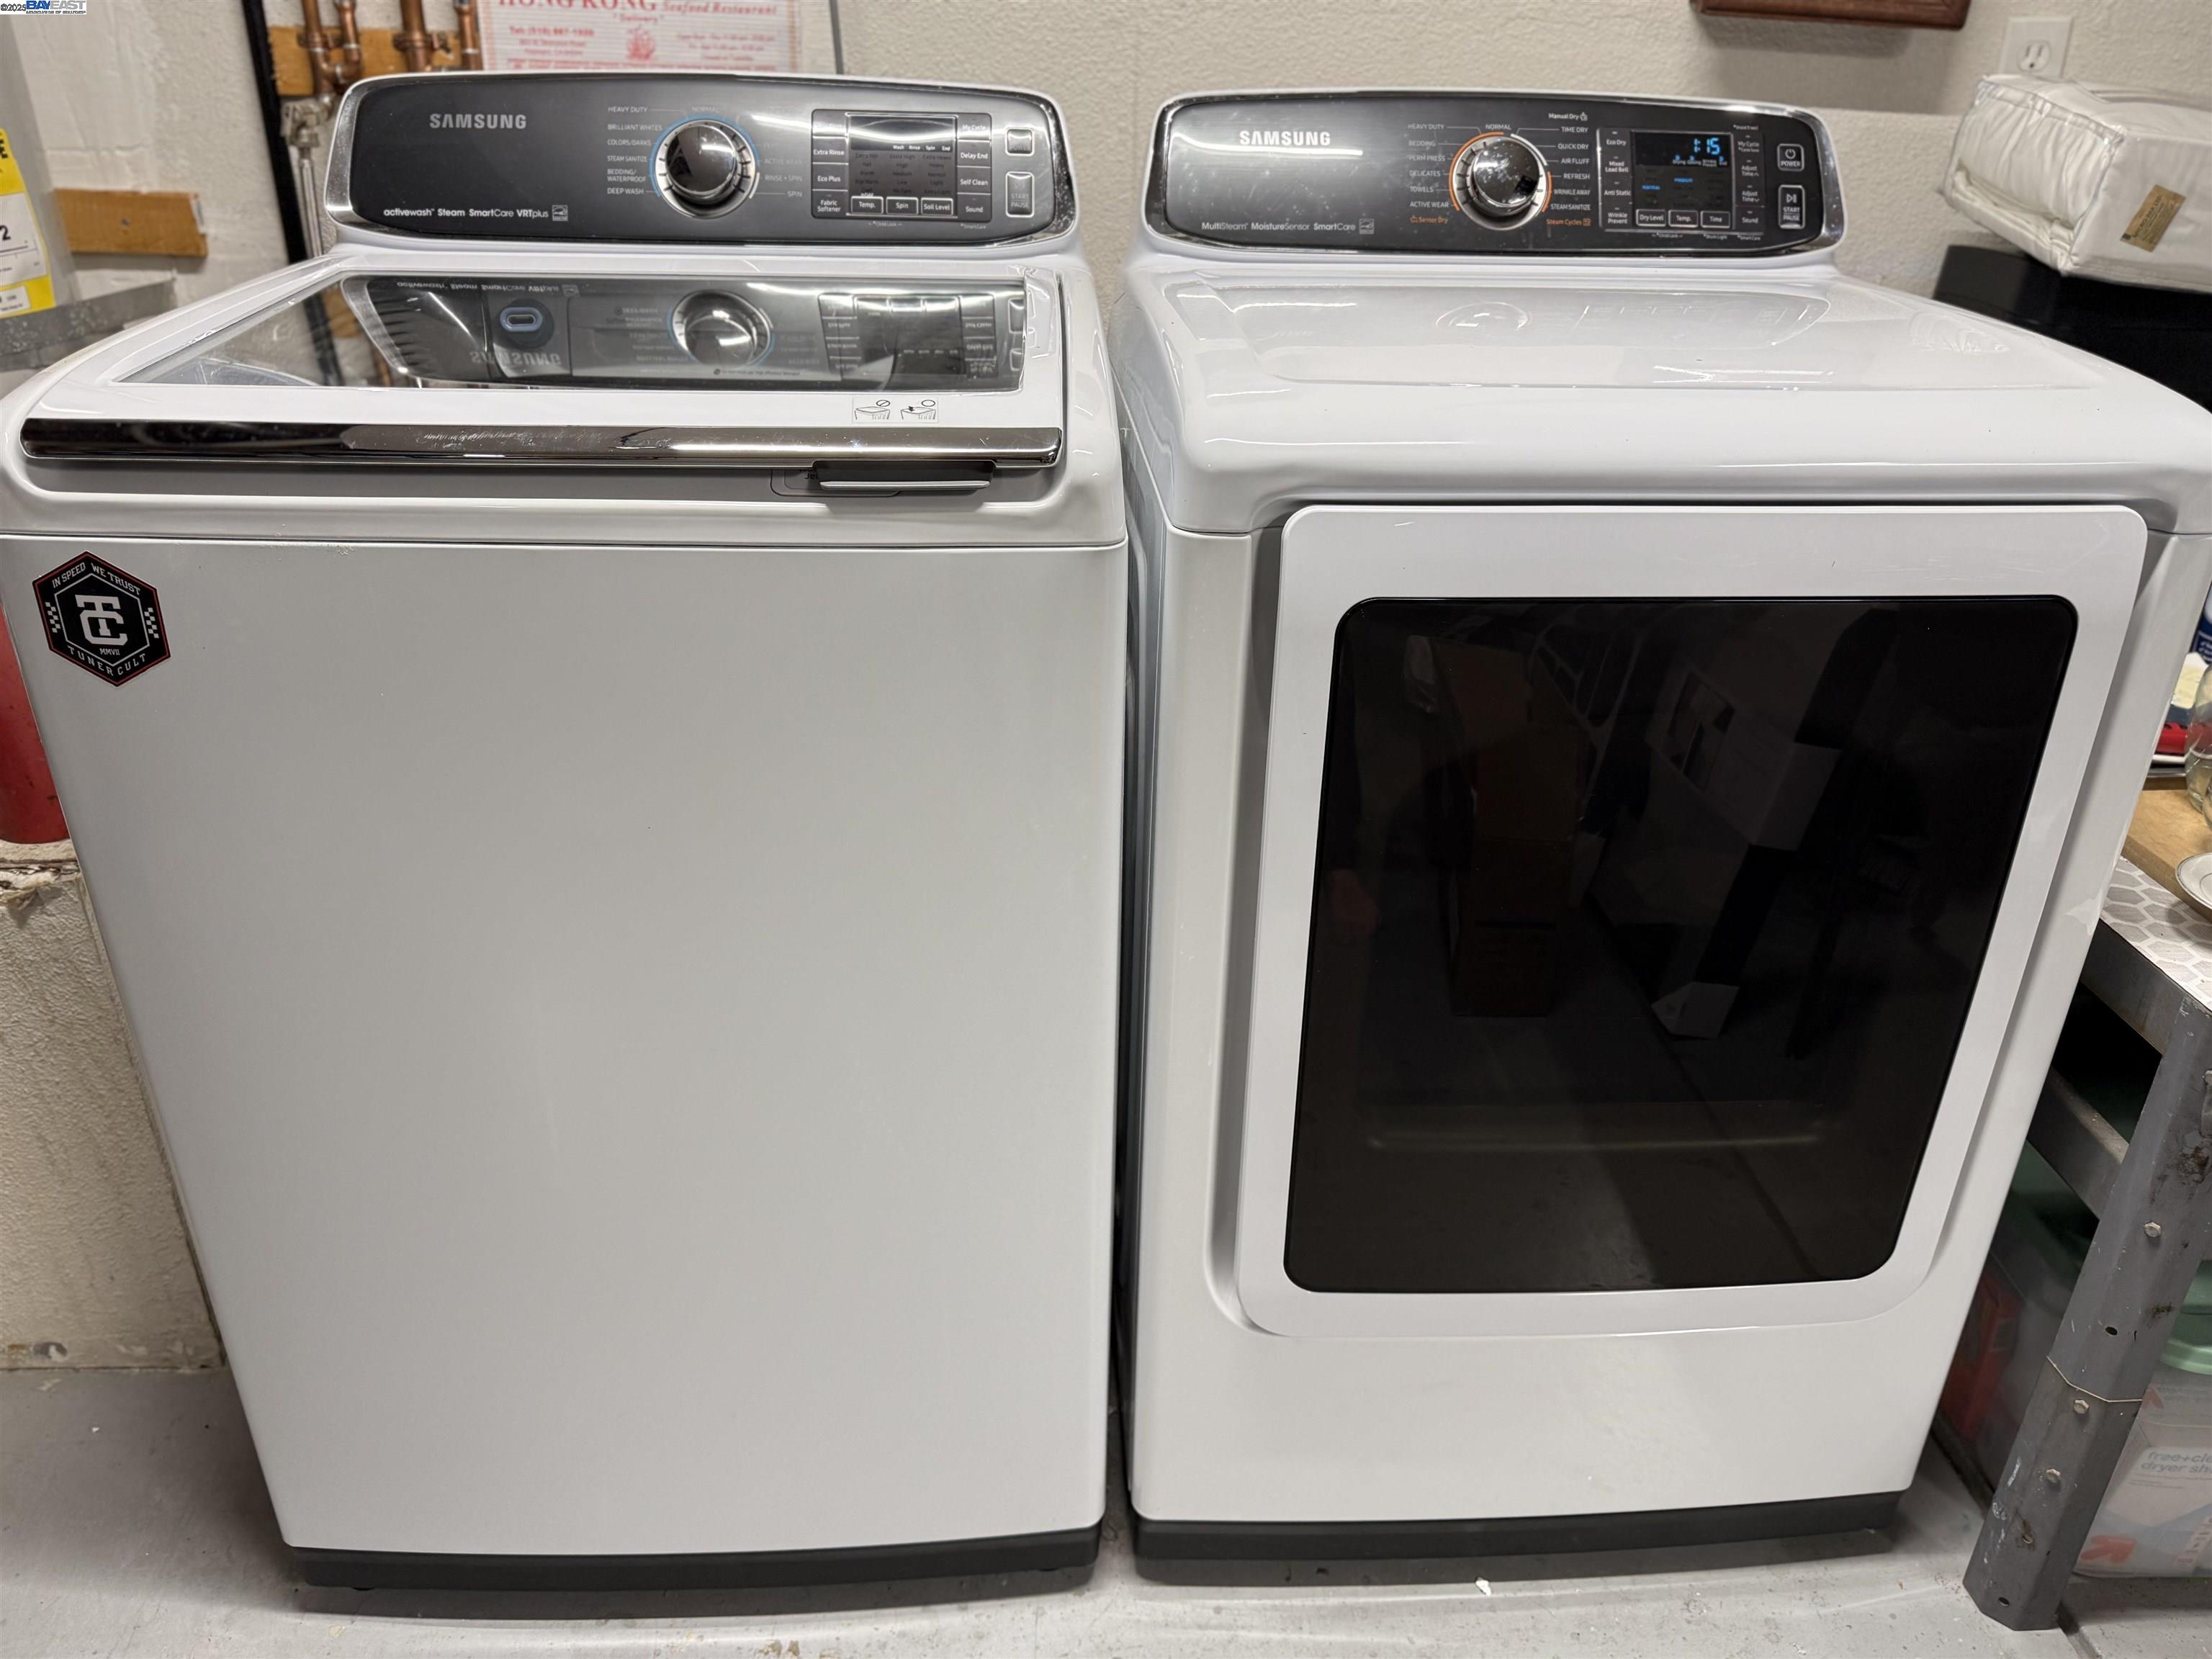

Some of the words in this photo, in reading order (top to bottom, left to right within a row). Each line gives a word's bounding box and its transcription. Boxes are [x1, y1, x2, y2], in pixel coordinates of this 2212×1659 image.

[430, 114, 527, 130] SAMSUNG
[1570, 113, 1579, 122] Dry
[1239, 130, 1331, 146] SAMSUNG
[1694, 138, 1720, 156] 1:15
[858, 201, 876, 210] Temp.
[438, 208, 466, 217] Steam
[469, 208, 514, 217] SmartCare
[516, 209, 549, 218] VRTplus
[1251, 222, 1310, 231] MoistureSensor
[1313, 222, 1356, 231] SmartCare
[52, 577, 61, 588] IN
[61, 562, 86, 583] SPEED
[91, 562, 107, 578] WE
[107, 571, 140, 595] TRUST
[67, 645, 114, 676] TUNER
[117, 653, 145, 675] CULT
[2141, 1461, 2188, 1474] dryer
